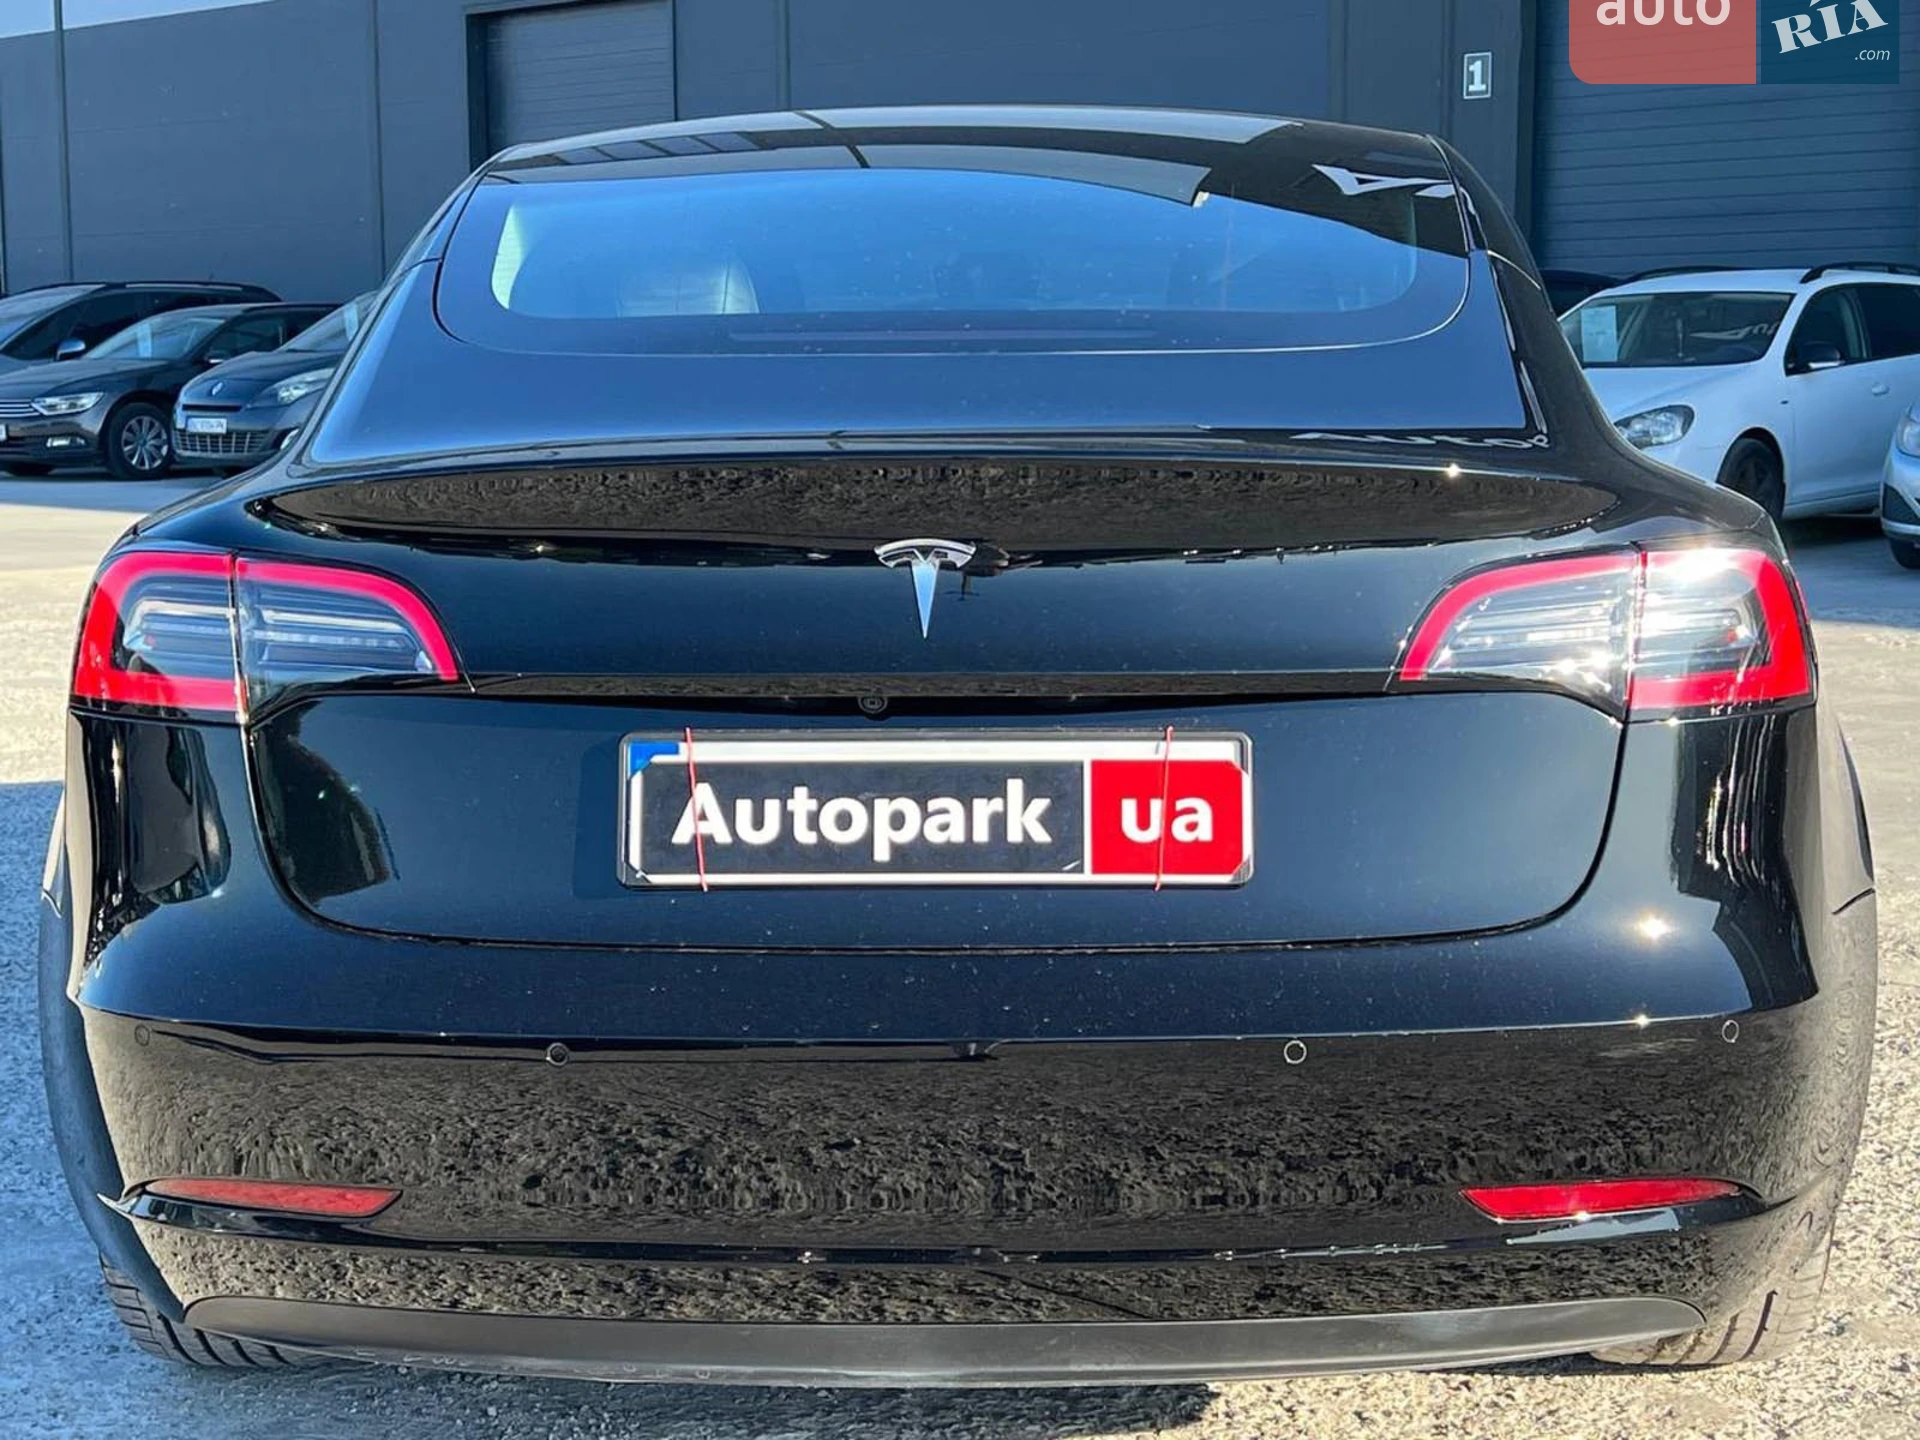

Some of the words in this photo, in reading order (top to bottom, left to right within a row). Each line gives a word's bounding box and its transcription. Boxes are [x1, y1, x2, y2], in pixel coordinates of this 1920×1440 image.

[1468, 60, 1487, 92] 1
[671, 778, 1053, 863] Autopark
[1121, 796, 1214, 844] ua
